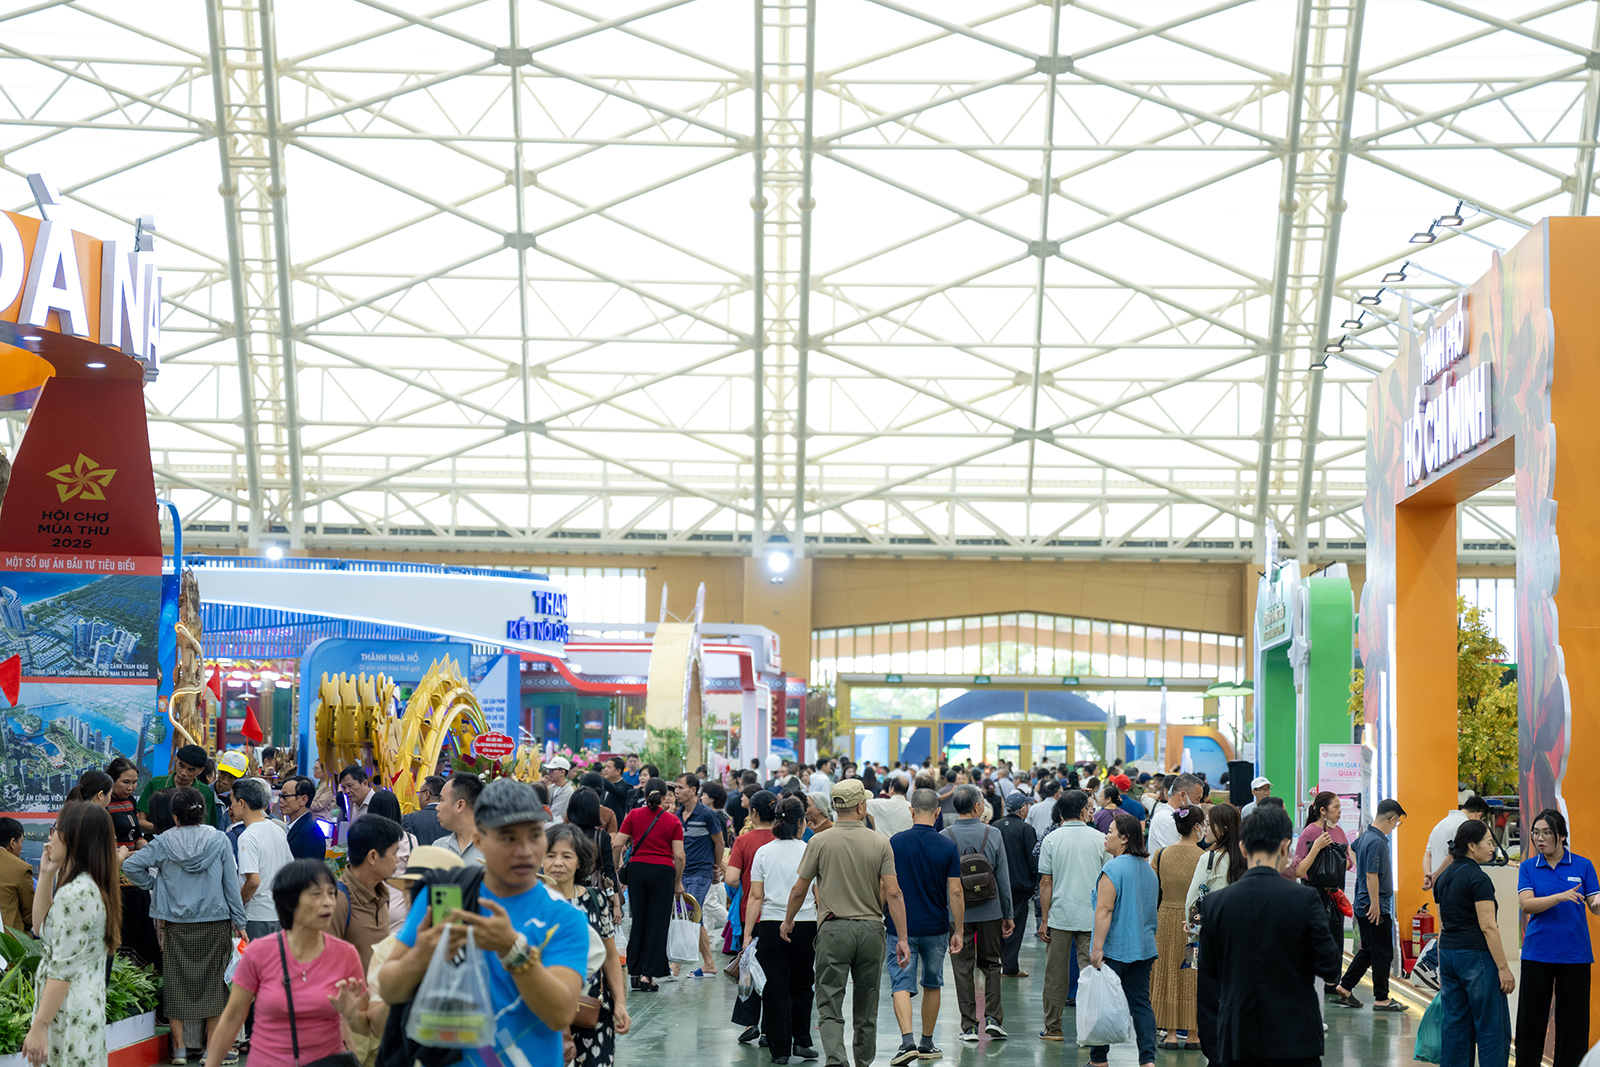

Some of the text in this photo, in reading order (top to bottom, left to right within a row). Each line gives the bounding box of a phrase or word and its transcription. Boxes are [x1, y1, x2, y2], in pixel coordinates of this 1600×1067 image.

[1404, 361, 1494, 488] HỒ CHÍ MINH
[42, 509, 110, 524] HỘI CHỢ
[78, 525, 110, 536] THU
[51, 538, 92, 549] 2025
[5, 555, 136, 571] MỘT SỐ DỰ ÁN ĐẦU TƯ TIÊU BIỂU
[506, 616, 534, 640] KẾT
[534, 617, 554, 641] NỐI
[361, 651, 387, 662] THÀNH
[388, 652, 406, 662] NHÀ
[1325, 761, 1345, 769] THAM
[1344, 761, 1358, 769] GIA
[26, 792, 34, 801] ÁN
[35, 793, 50, 802] CÔNG
